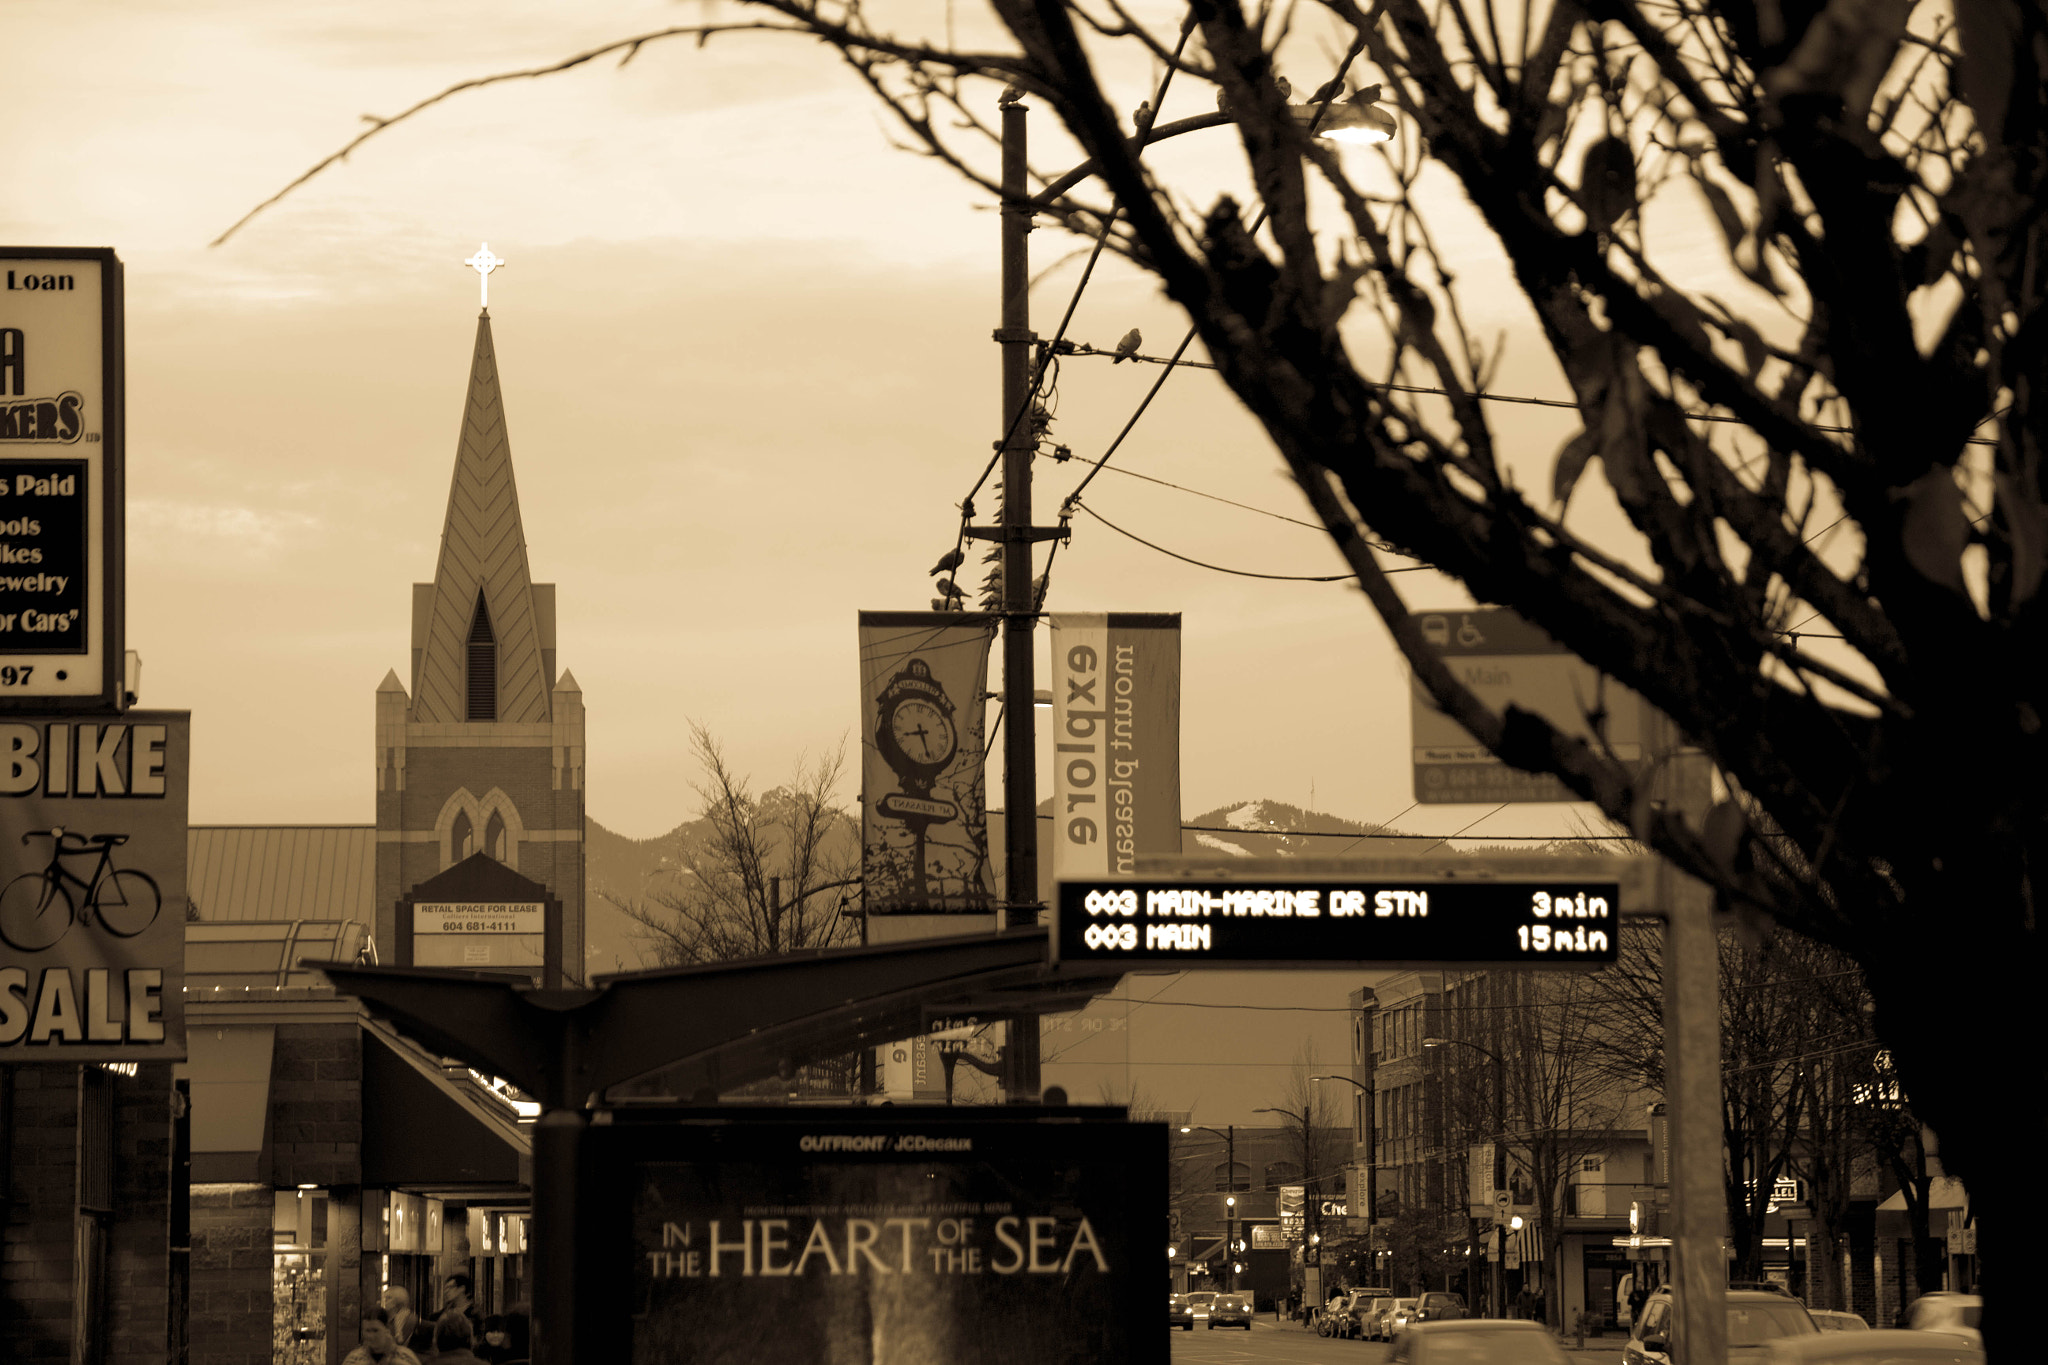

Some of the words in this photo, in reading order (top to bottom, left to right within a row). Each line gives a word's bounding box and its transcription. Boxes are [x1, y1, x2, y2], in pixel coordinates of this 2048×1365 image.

[7, 270, 75, 290] Loan
[16, 473, 75, 496] Paid
[1, 665, 34, 686] 97
[1465, 666, 1511, 685] Main
[0, 723, 166, 797] BIKE
[421, 905, 453, 913] RETAIL
[455, 905, 485, 913] SPACE
[487, 905, 506, 913] FOR
[508, 905, 538, 913] LEASE
[1085, 890, 1138, 916] 003
[1146, 890, 1321, 916] MAIN-MARINE
[1329, 890, 1365, 916] DR
[1374, 890, 1428, 916] STN
[442, 921, 463, 931] 604
[466, 921, 516, 931] 681-4111
[1085, 923, 1138, 951] 003
[1146, 923, 1211, 951] MAIN
[0, 968, 164, 1044] SALE
[800, 1135, 884, 1152] OUTFRONT
[894, 1135, 973, 1152] JCDecaux
[662, 1222, 690, 1248] IN
[937, 1218, 974, 1245] OF
[709, 1218, 932, 1276] HEART
[992, 1216, 1110, 1274] SEA
[647, 1250, 701, 1278] THE
[928, 1248, 982, 1274] THE
